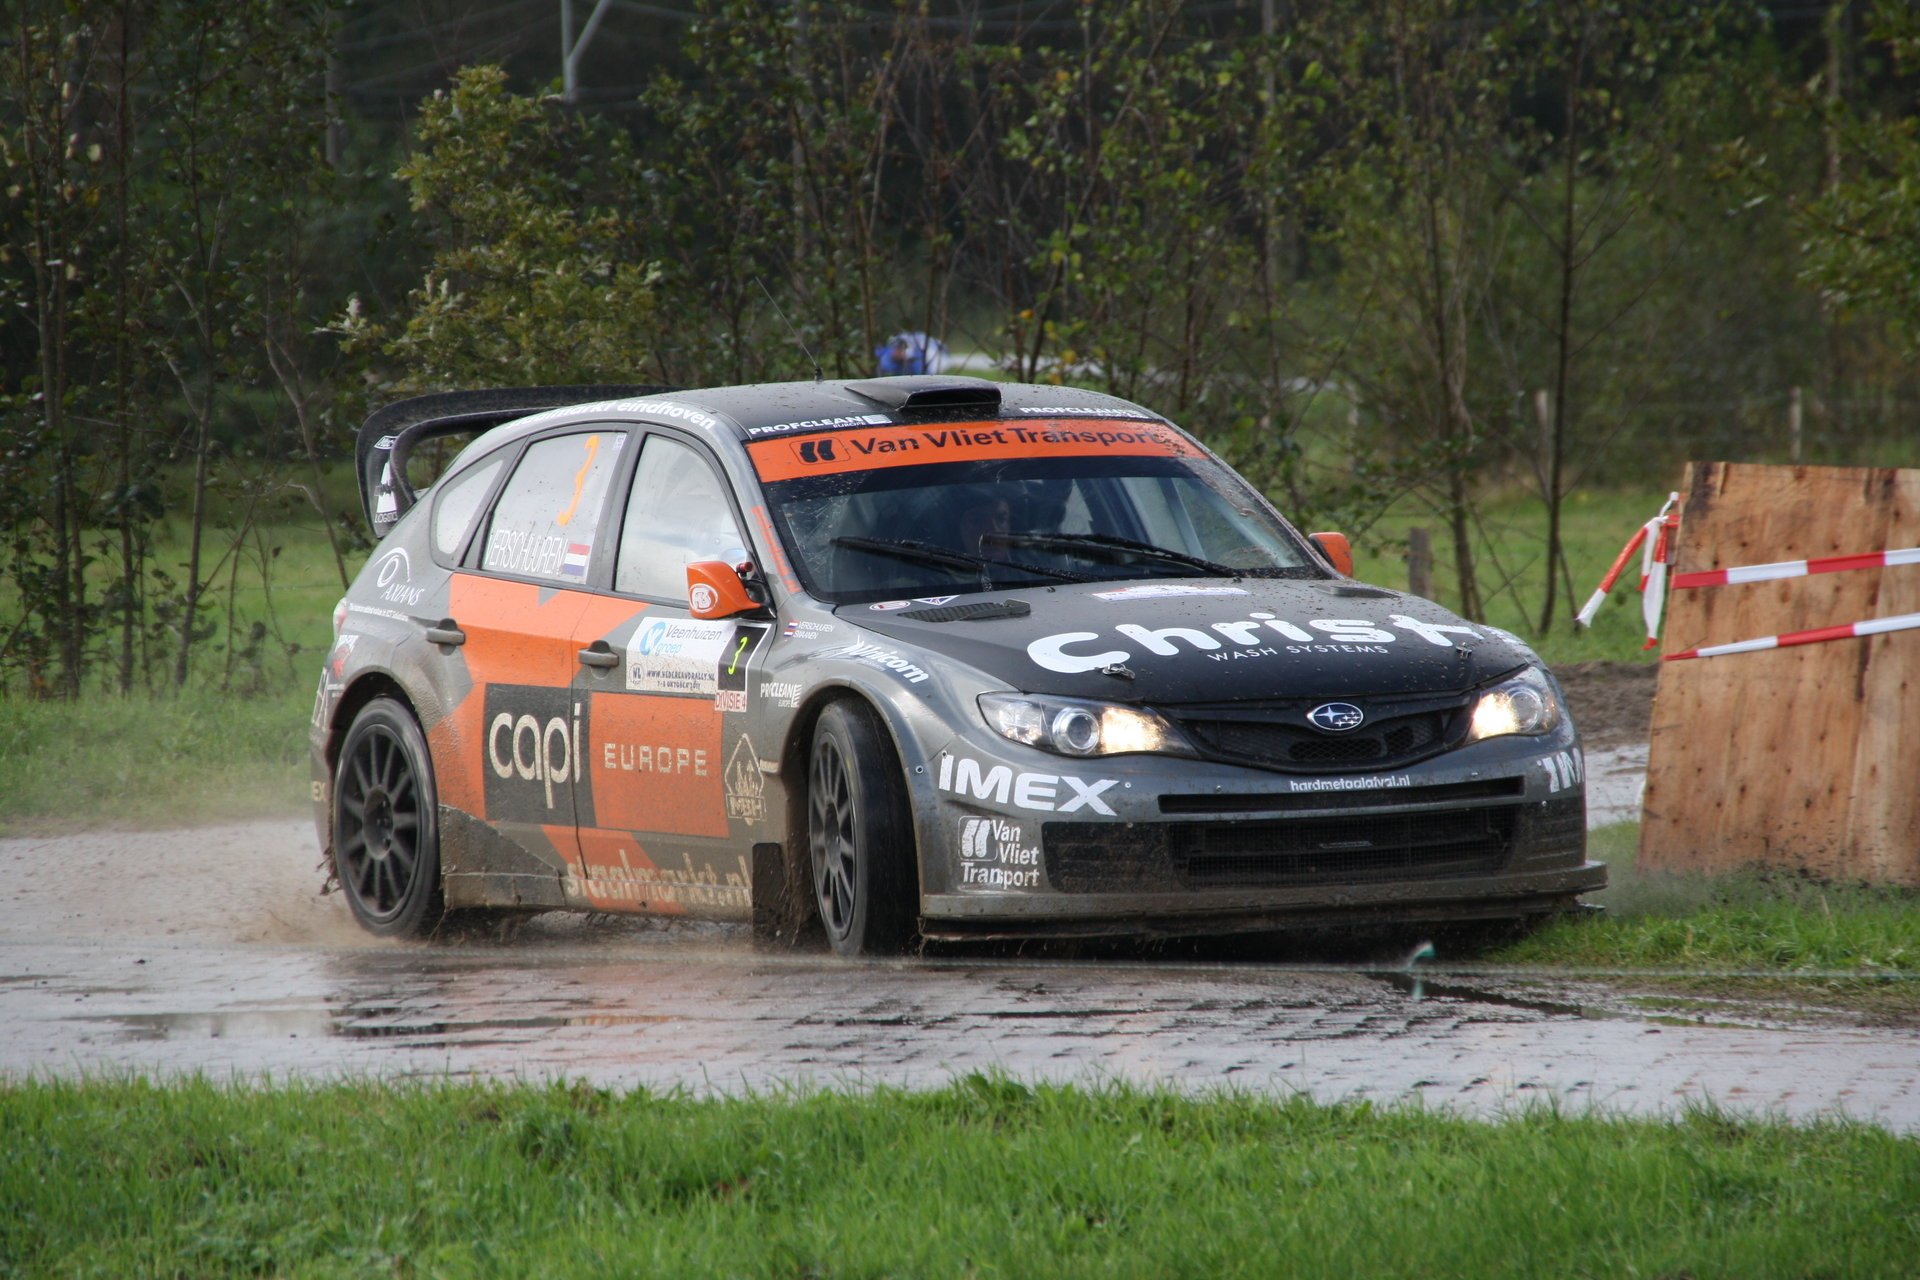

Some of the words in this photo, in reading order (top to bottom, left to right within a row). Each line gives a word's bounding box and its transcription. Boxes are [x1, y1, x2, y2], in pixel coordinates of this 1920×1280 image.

[617, 399, 717, 430] eindhoven
[748, 416, 864, 435] PROFCLEAN
[849, 436, 920, 455] Van
[922, 427, 1008, 448] Vliet
[1006, 426, 1167, 446] Transport
[380, 583, 425, 605] AXIANS
[665, 624, 723, 642] Veenhuizen
[1026, 612, 1482, 674] Christ
[655, 642, 682, 657] groep
[1208, 645, 1279, 662] WASH
[1290, 643, 1390, 659] SYSTEMS
[850, 644, 929, 684] Unicorn
[715, 691, 742, 710] DIVISIE
[740, 692, 747, 710] 4
[488, 702, 582, 809] capi
[603, 742, 708, 777] EUROPE
[938, 753, 1121, 816] IMEX
[1290, 774, 1411, 792] hardmetaalafval.nl
[992, 819, 1022, 842] Van
[999, 842, 1039, 865] Vliet
[960, 862, 1040, 889] Transport
